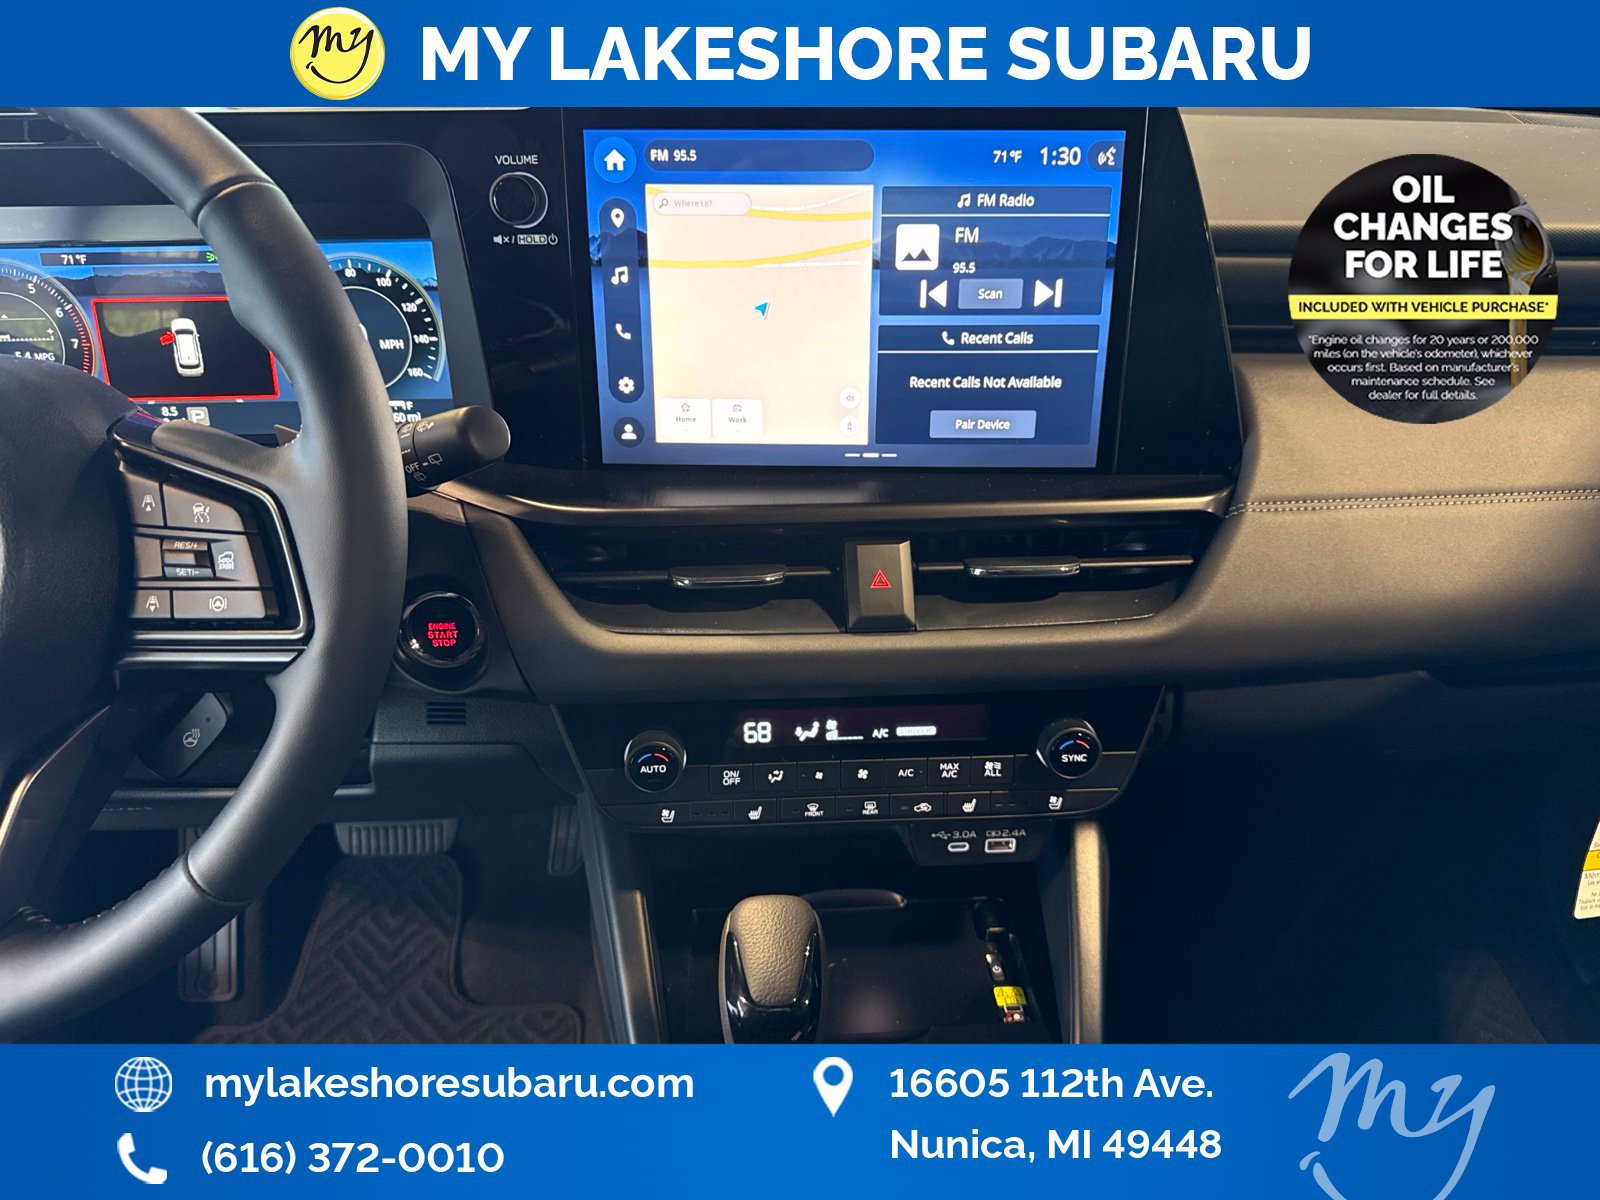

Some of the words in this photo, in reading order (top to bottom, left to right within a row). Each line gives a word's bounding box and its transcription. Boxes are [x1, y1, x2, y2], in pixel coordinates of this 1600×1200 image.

[495, 155, 538, 165] VOLUME
[650, 149, 669, 162] FM
[673, 150, 697, 162] 95.5
[1040, 147, 1081, 166] 1:30
[674, 200, 700, 208] Where
[702, 200, 713, 208] to?
[977, 194, 996, 207] FM
[999, 193, 1034, 207] Radio
[517, 234, 547, 245] HOLD
[954, 227, 980, 243] FM
[952, 261, 976, 274] 95.5
[344, 268, 357, 278] 80
[376, 278, 392, 287] 100
[27, 283, 37, 294] 5
[977, 288, 1003, 300] Scan
[56, 307, 64, 319] 6
[401, 303, 418, 313] 120
[413, 334, 429, 344] 140
[960, 332, 1002, 345] Recent
[1005, 331, 1034, 345] Calls
[71, 338, 79, 349] 7
[379, 339, 405, 350] MPH
[33, 352, 55, 361] MPG
[407, 368, 424, 378] 160
[909, 376, 950, 389] Recent
[952, 376, 980, 389] Calls
[983, 377, 1006, 389] Not
[1007, 376, 1062, 389] Available
[406, 401, 413, 410] F
[161, 406, 178, 417] 8.5
[955, 419, 974, 430] Pair
[977, 419, 1010, 430] Device
[405, 462, 420, 473] OFF
[428, 631, 458, 639] START
[432, 639, 457, 647] STOP
[743, 721, 772, 743] 68
[872, 728, 889, 738] A/C
[1061, 753, 1087, 763] SYNC
[640, 765, 667, 774] AUTO
[940, 763, 960, 771] MAX
[723, 770, 740, 779] ON/
[898, 768, 914, 777] A/C
[941, 770, 958, 778] A/C
[984, 769, 1002, 777] ALL
[723, 778, 741, 786] OFF
[952, 830, 977, 839] 3.0A
[1001, 829, 1026, 838] 2.4A
